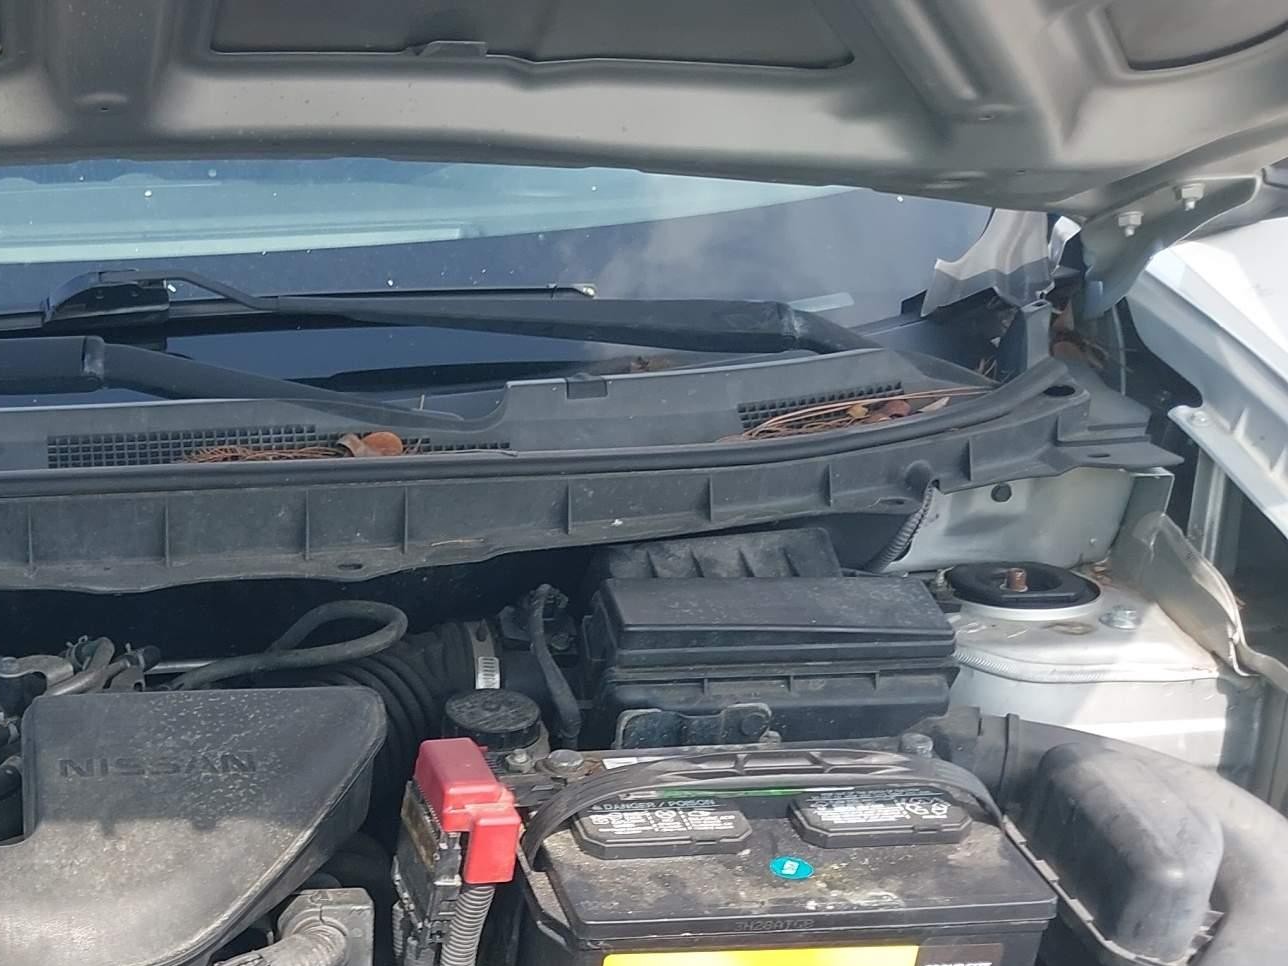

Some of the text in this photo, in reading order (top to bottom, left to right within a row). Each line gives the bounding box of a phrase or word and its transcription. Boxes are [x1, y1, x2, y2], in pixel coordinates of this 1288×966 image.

[59, 753, 257, 777] NISSAN
[603, 802, 657, 810] DANGER
[669, 799, 715, 808] POISON
